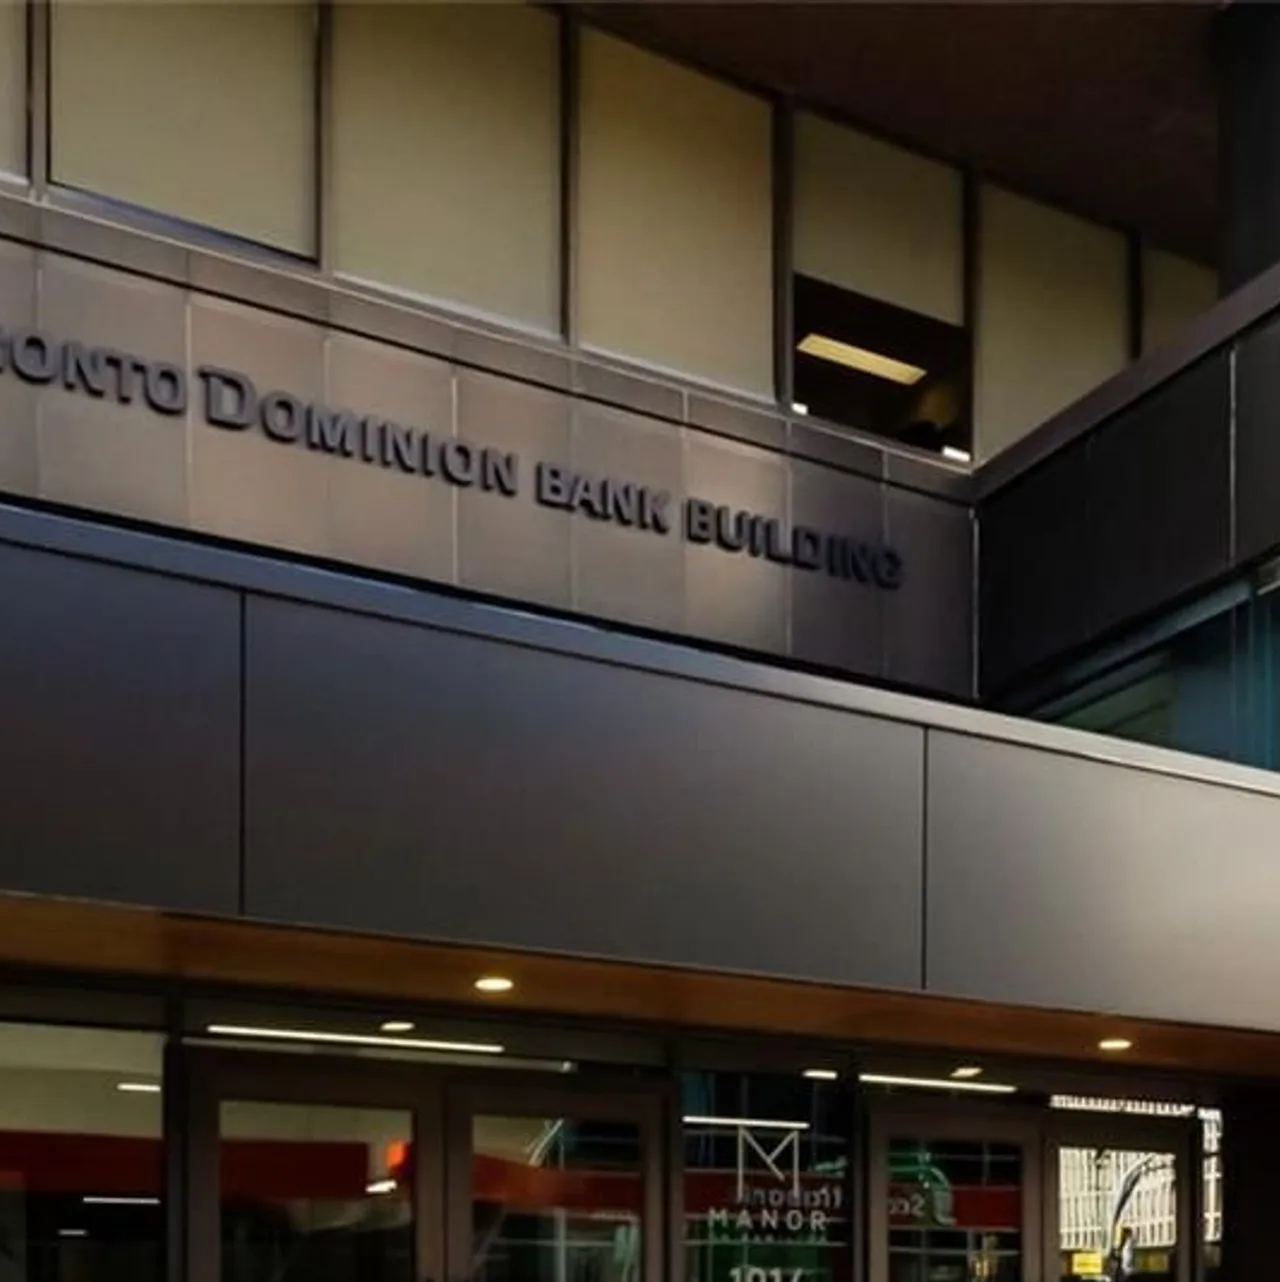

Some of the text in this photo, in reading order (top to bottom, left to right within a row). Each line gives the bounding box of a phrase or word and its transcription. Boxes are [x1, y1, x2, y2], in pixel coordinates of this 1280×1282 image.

[197, 364, 518, 497] DOMINION
[535, 461, 669, 534] BANK
[683, 499, 904, 590] BUILDING
[708, 1207, 827, 1231] MANOR
